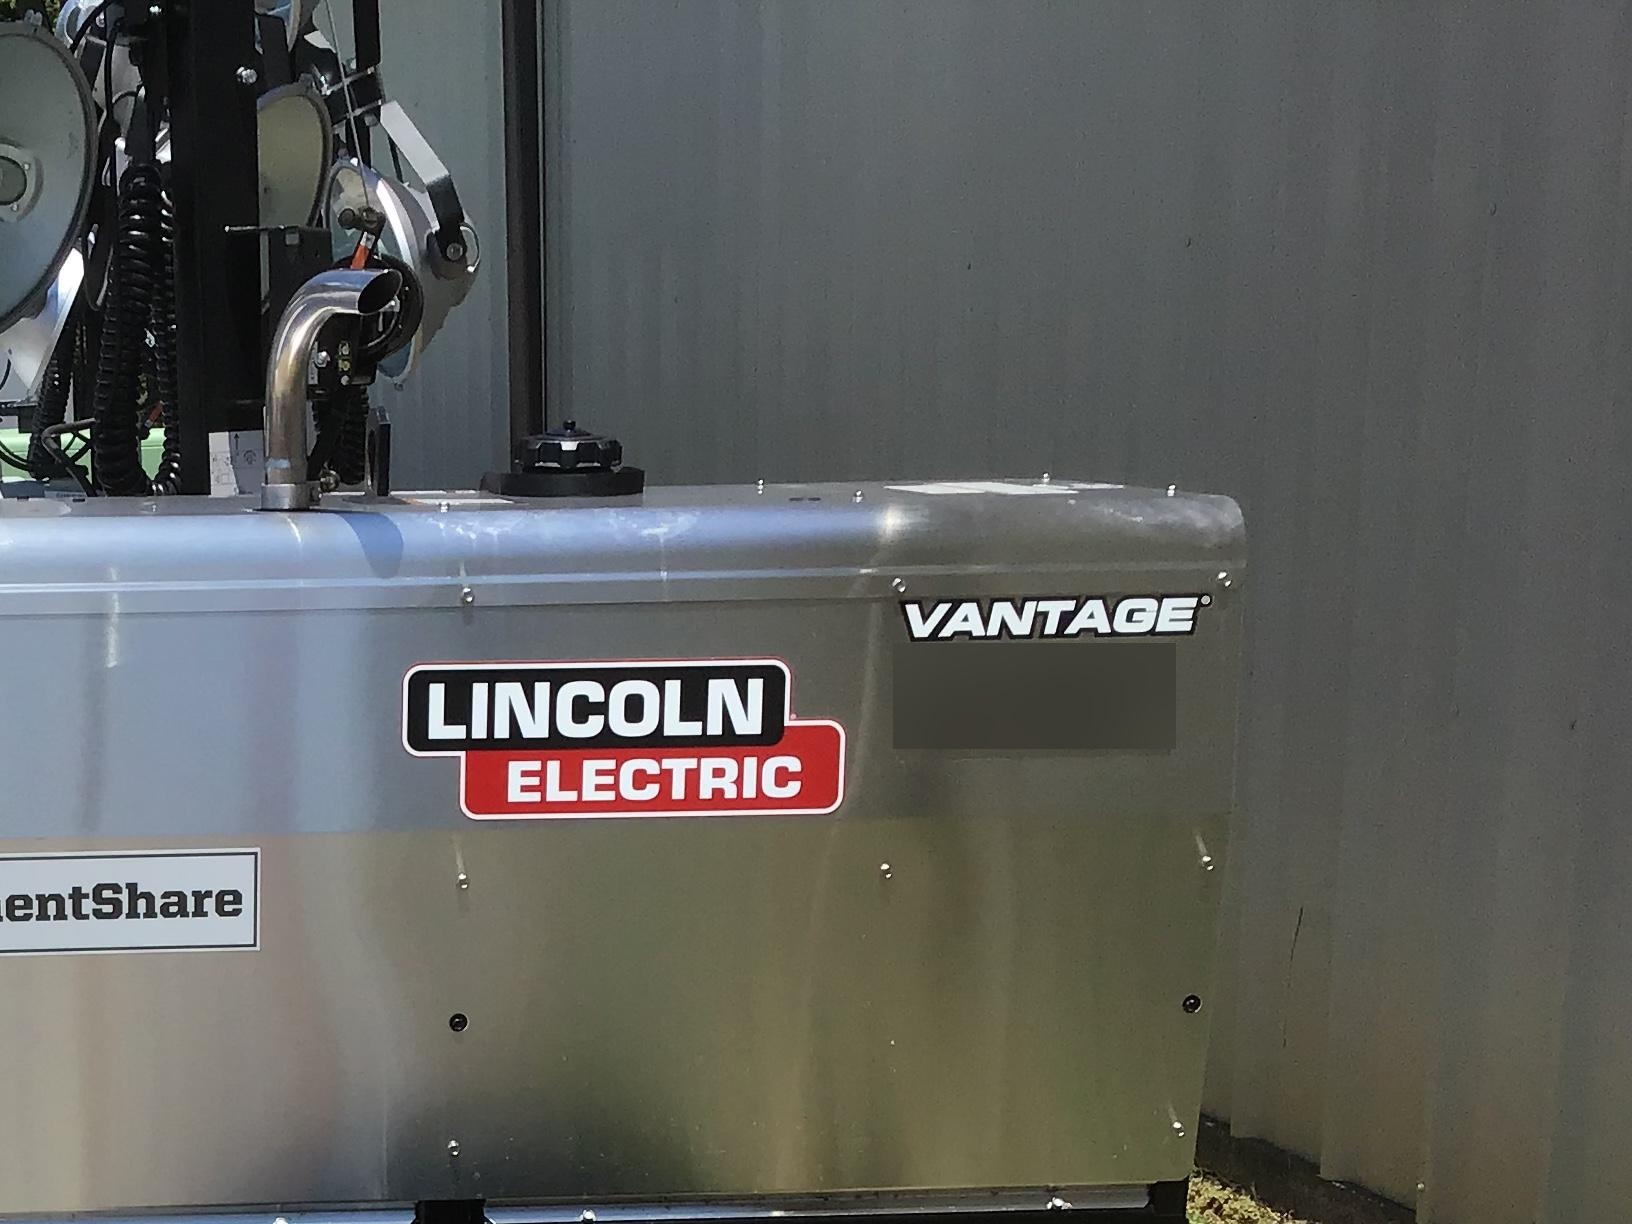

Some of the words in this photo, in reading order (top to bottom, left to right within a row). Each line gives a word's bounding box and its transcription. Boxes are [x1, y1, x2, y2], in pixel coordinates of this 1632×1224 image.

[904, 597, 1200, 639] VANTAGE
[427, 677, 764, 741] LINCOLN
[506, 757, 803, 803] ELECTRIC
